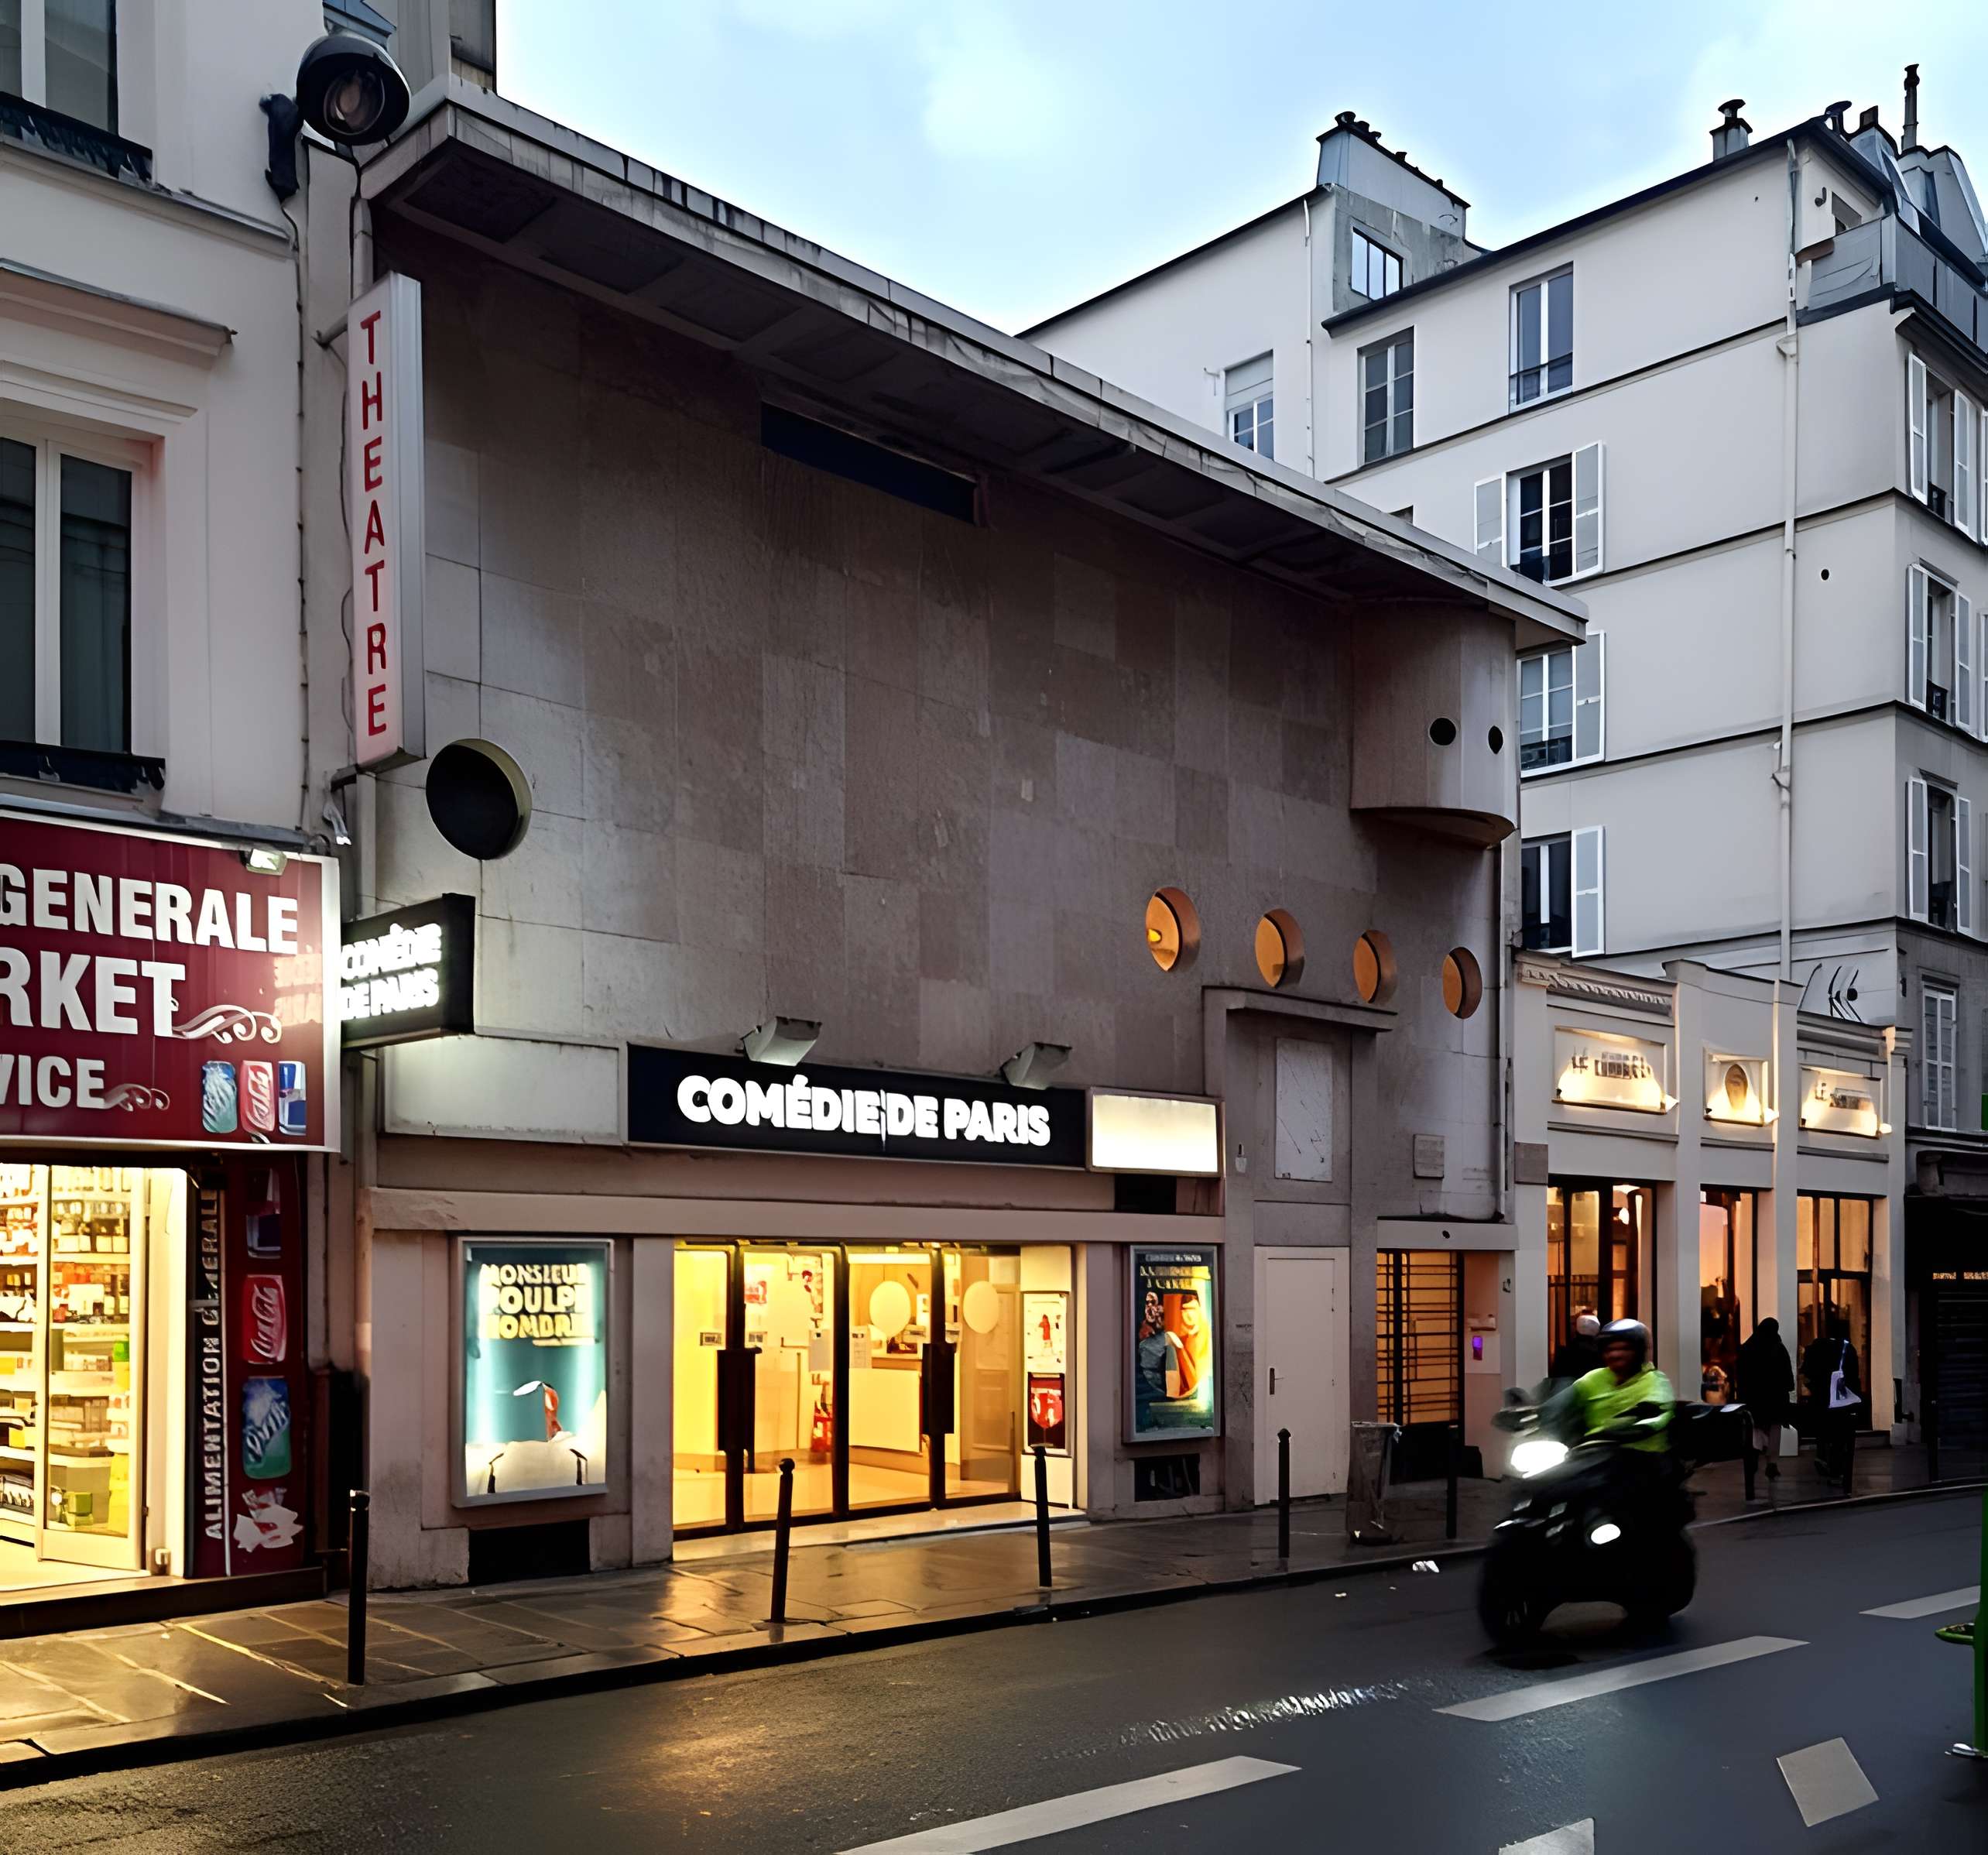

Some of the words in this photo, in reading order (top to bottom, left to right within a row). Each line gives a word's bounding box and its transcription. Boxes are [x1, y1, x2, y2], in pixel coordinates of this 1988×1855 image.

[360, 310, 386, 737] THEATRE
[0, 863, 297, 955] GENERALE
[677, 1075, 881, 1134] COMÉDIE
[886, 1092, 938, 1138] DE
[944, 1098, 1051, 1146] PARIS
[480, 1264, 588, 1285] MONSIEU
[480, 1285, 588, 1314] OULP
[203, 1337, 223, 1539] ALIMENTATION
